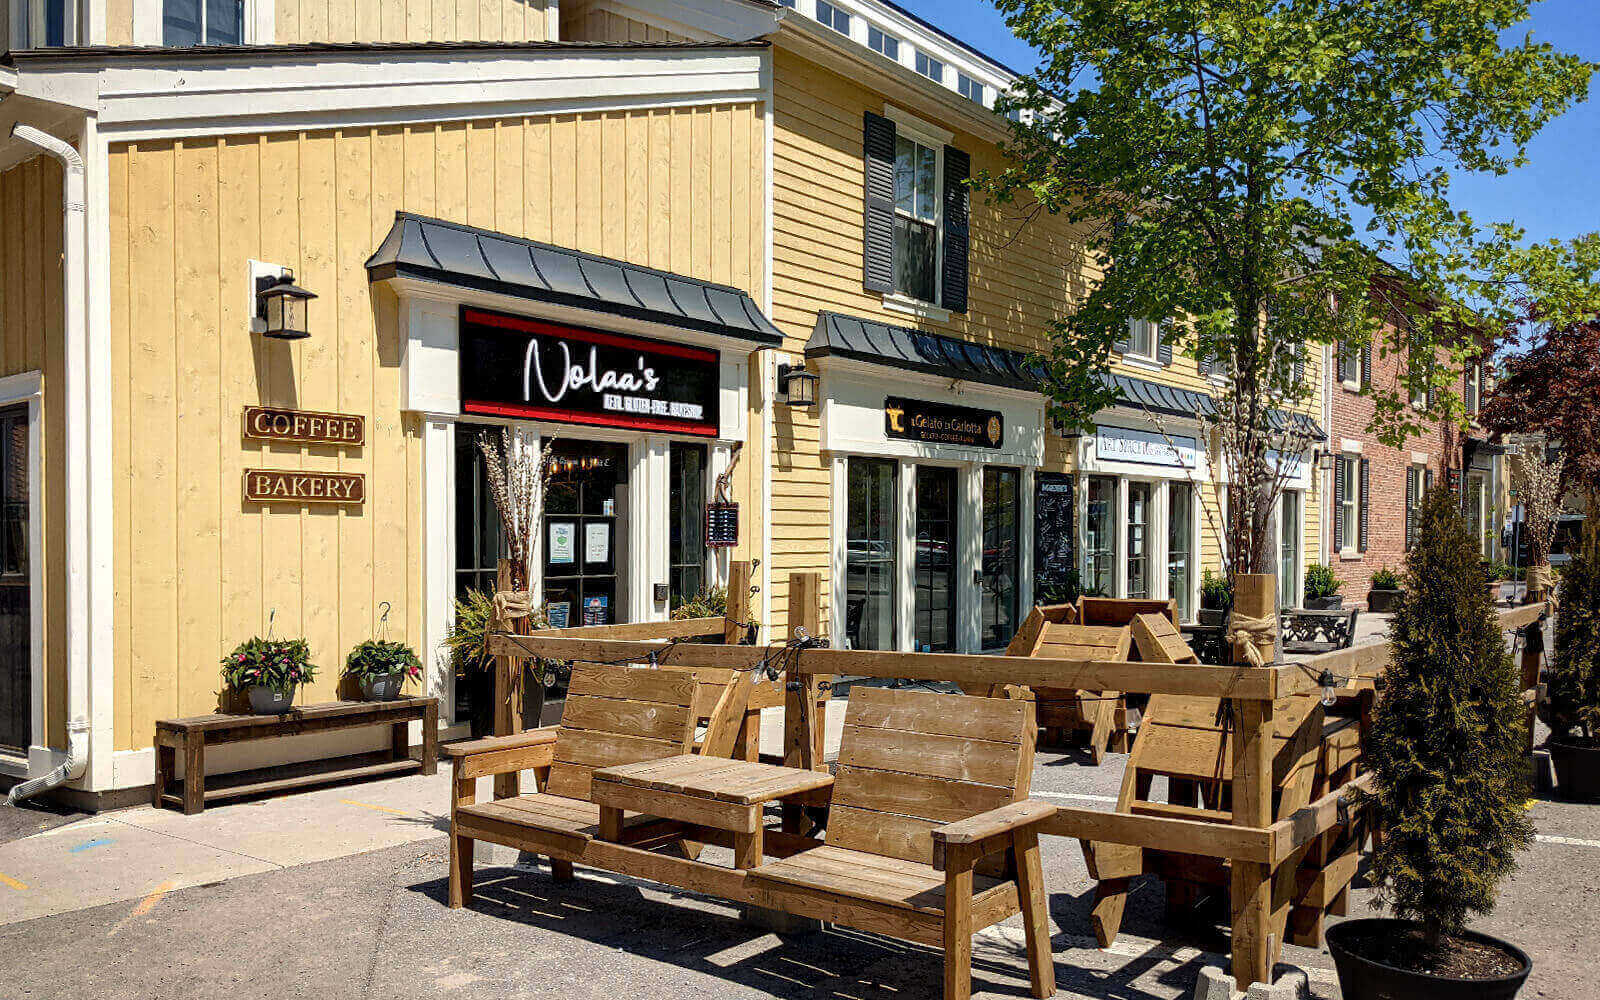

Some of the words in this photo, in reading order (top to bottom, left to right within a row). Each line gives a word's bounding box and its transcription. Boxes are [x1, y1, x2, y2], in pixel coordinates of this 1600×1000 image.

[523, 338, 660, 402] Nolaa's
[254, 413, 356, 440] COFFEE
[916, 414, 943, 430] Gelato
[255, 475, 356, 498] BAKERY
